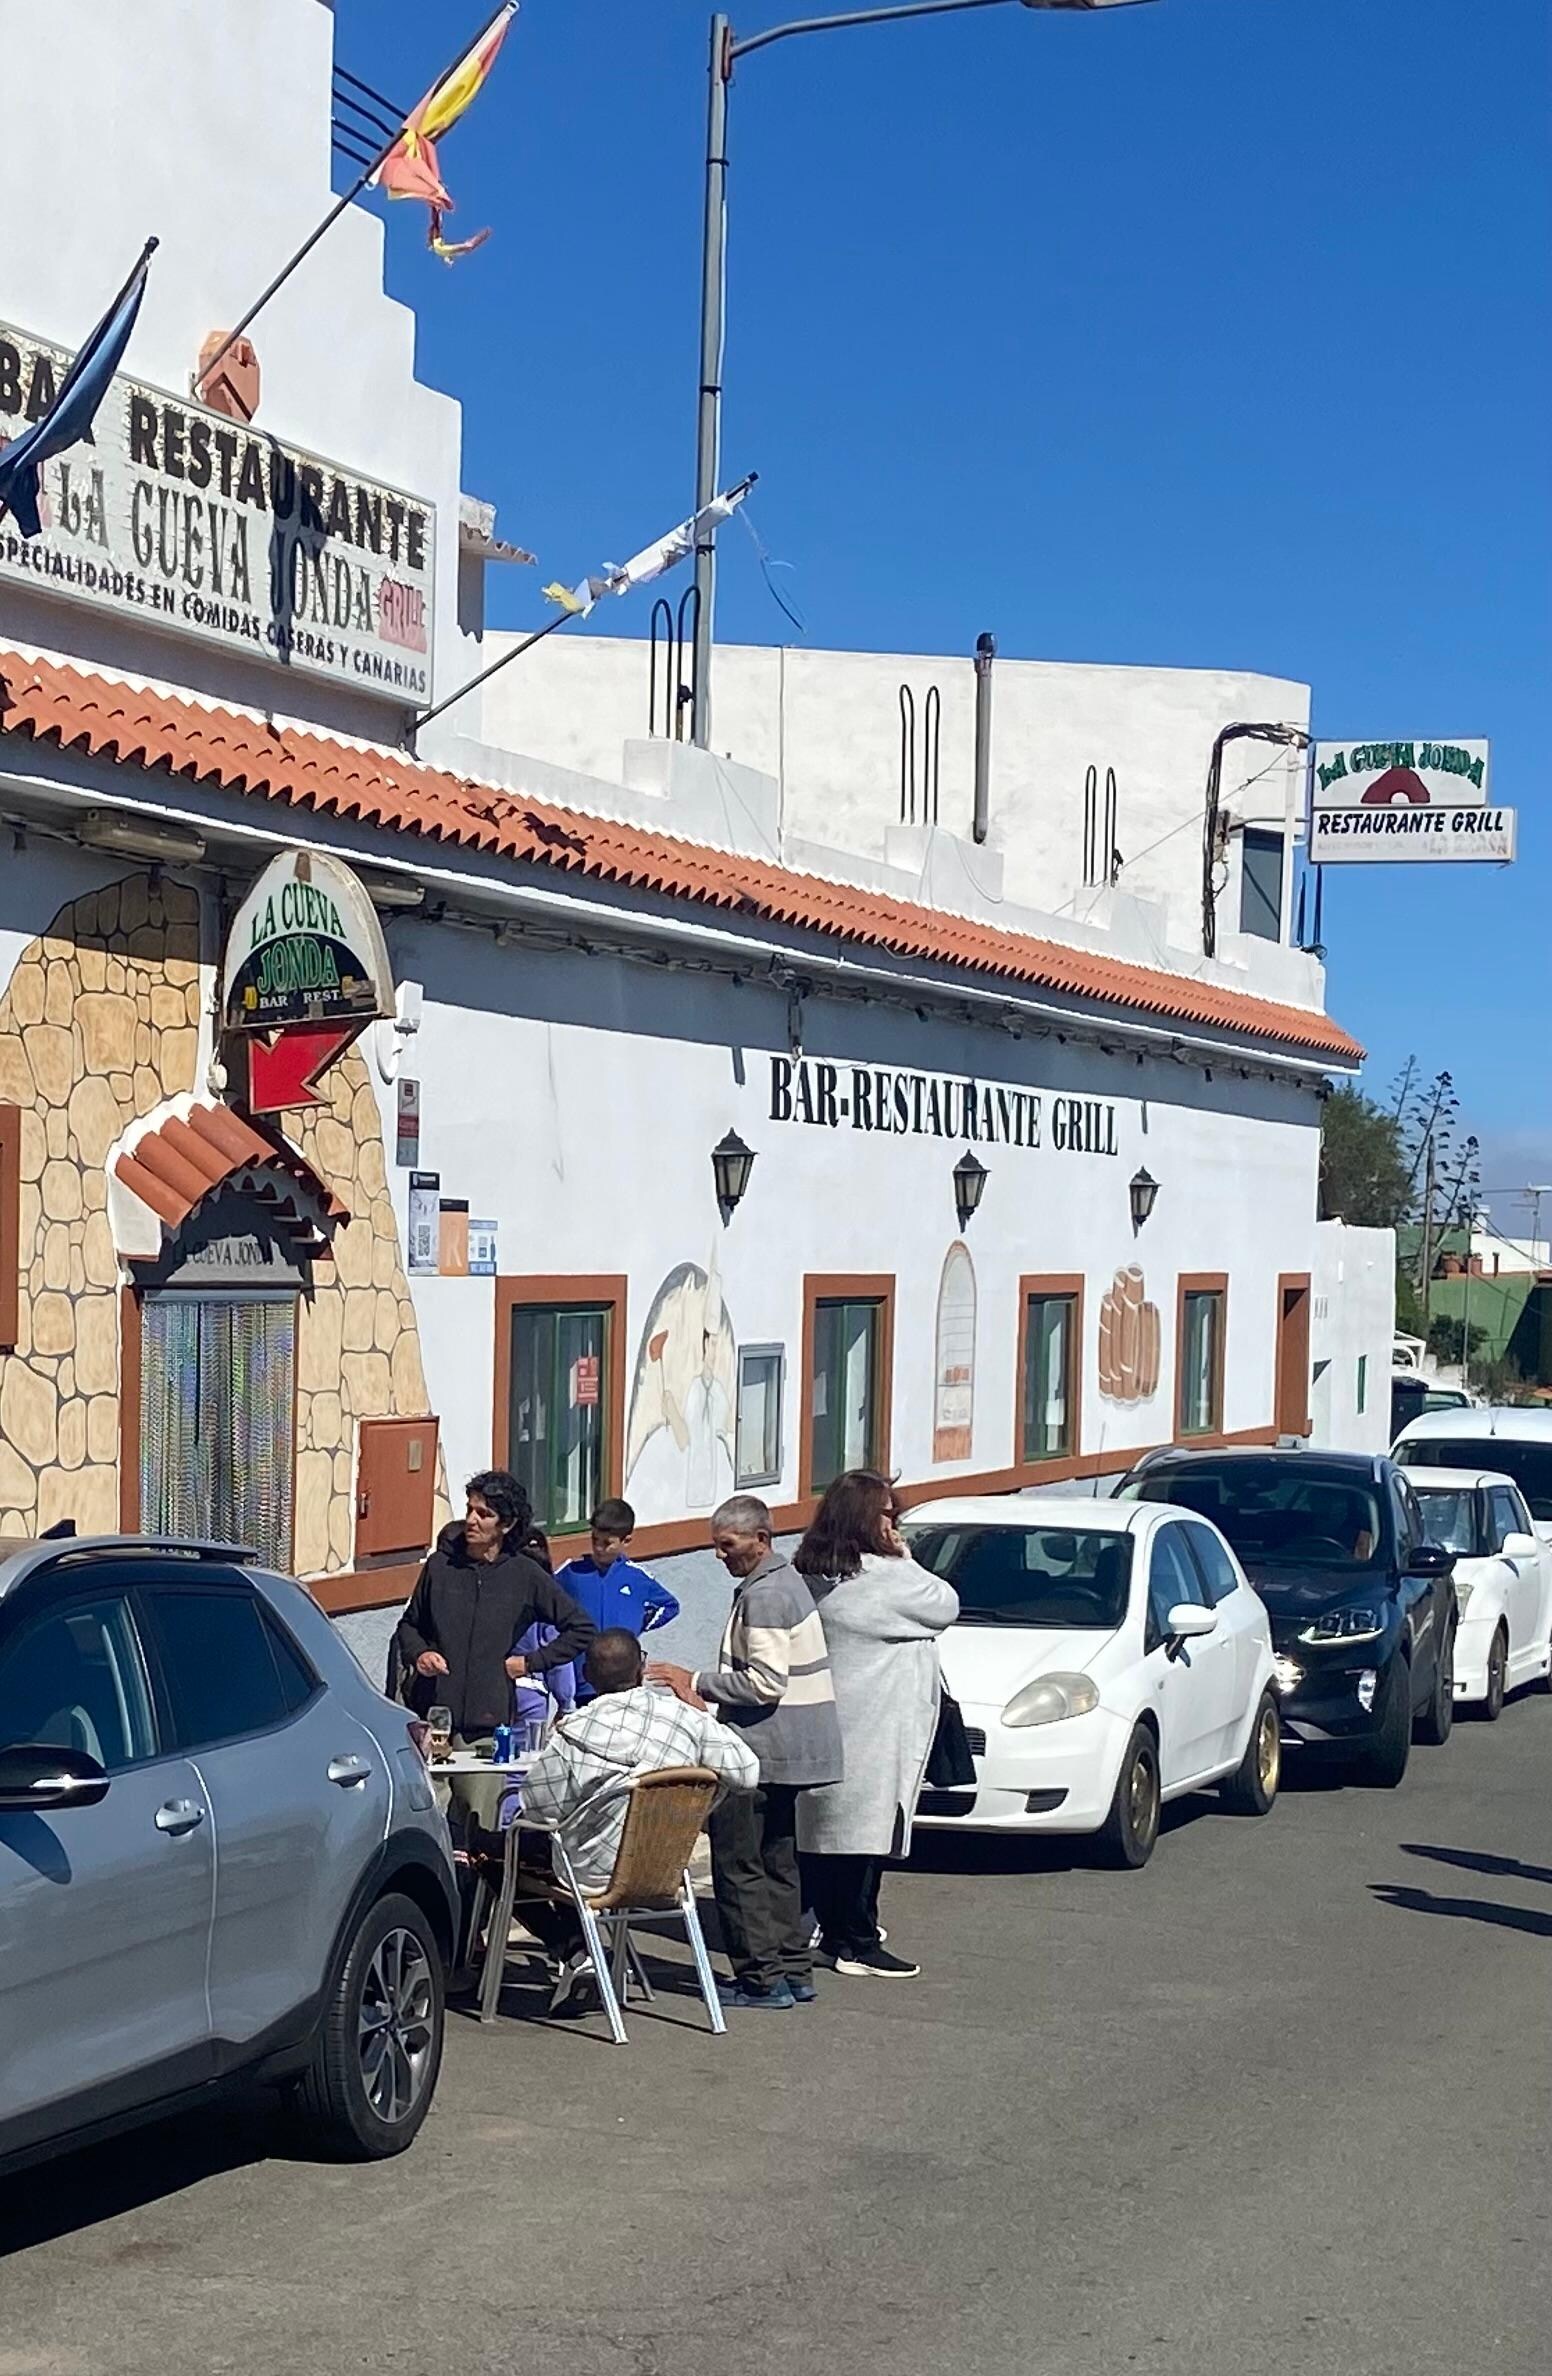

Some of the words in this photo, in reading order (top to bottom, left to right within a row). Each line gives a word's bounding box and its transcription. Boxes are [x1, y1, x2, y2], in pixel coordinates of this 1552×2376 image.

[0, 341, 57, 423] BA
[131, 395, 425, 570] RESTAURANTE
[59, 461, 109, 549] LA
[271, 531, 374, 632] JONDA
[153, 583, 174, 613] EN
[183, 591, 260, 641] COMIDAS
[267, 621, 334, 665] CASERAS
[340, 648, 348, 668] Y
[354, 650, 426, 693] CANARIAS
[1318, 812, 1446, 835] RESTAURANTE
[1452, 811, 1504, 832] GRILL
[251, 896, 276, 949] LA
[282, 883, 347, 938] CUEVA
[257, 936, 340, 994] JONDA
[259, 996, 289, 1009] BAR
[1052, 1097, 1119, 1156] GRILL
